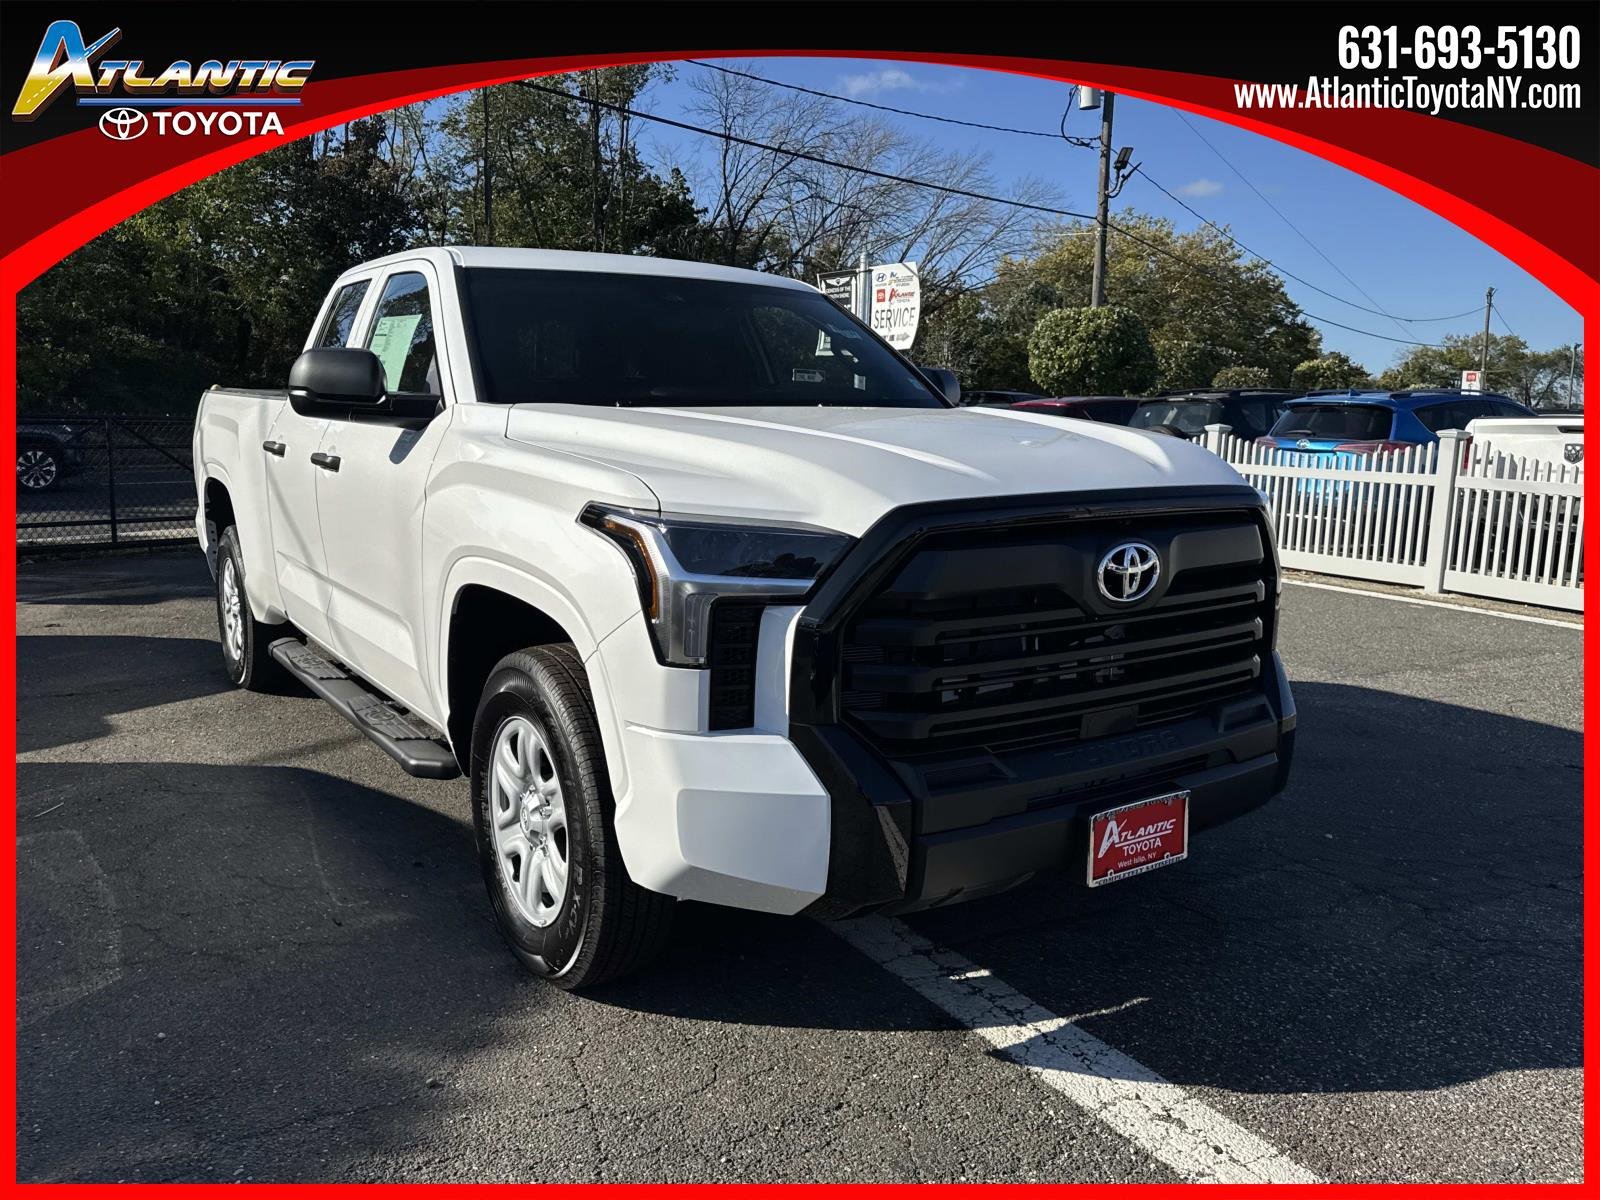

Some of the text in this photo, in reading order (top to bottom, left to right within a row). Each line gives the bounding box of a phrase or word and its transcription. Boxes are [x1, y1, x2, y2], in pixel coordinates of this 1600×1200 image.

[873, 307, 916, 329] SERVICE
[1098, 819, 1176, 858] ATLANTIC
[1123, 838, 1162, 857] TOYOTA
[1117, 858, 1132, 869] West
[1148, 851, 1157, 860] NY
